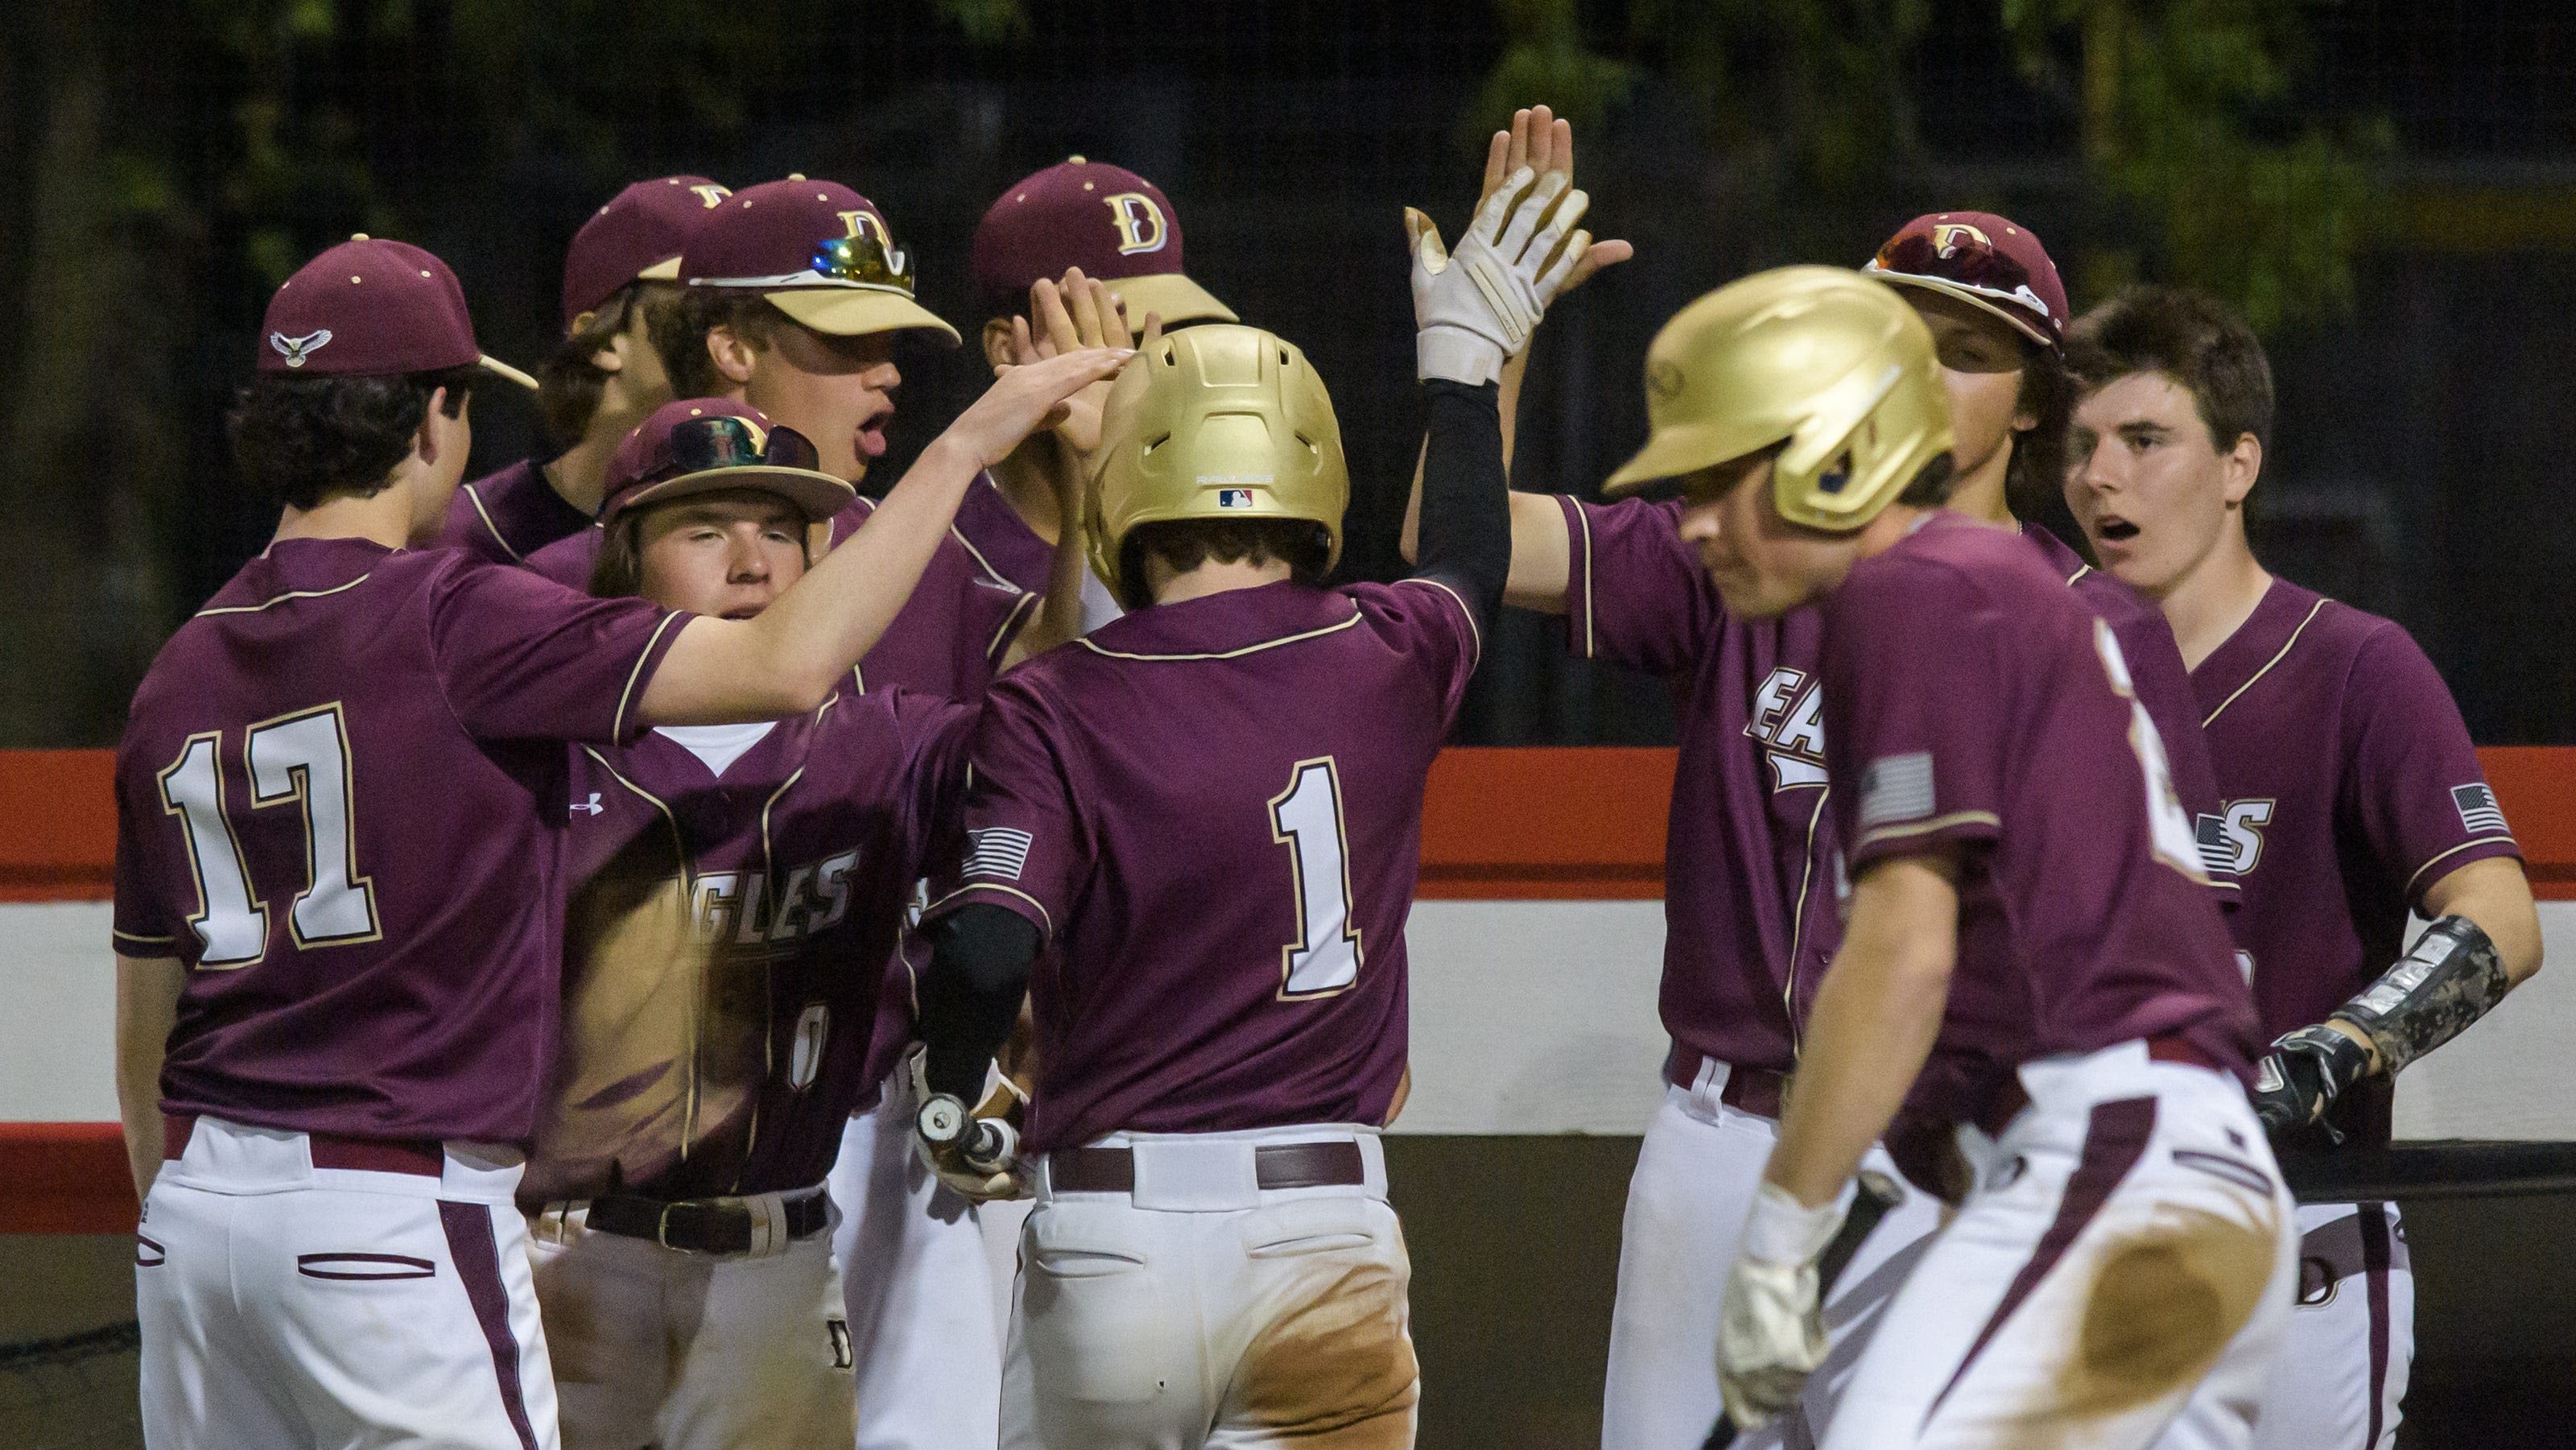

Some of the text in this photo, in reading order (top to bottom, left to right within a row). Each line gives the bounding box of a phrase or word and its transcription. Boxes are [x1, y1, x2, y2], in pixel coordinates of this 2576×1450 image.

[1104, 192, 1167, 256] D
[157, 700, 383, 970] 17
[1266, 754, 1364, 1002] 1
[668, 845, 862, 950] GLES
[789, 1000, 830, 1092] 0
